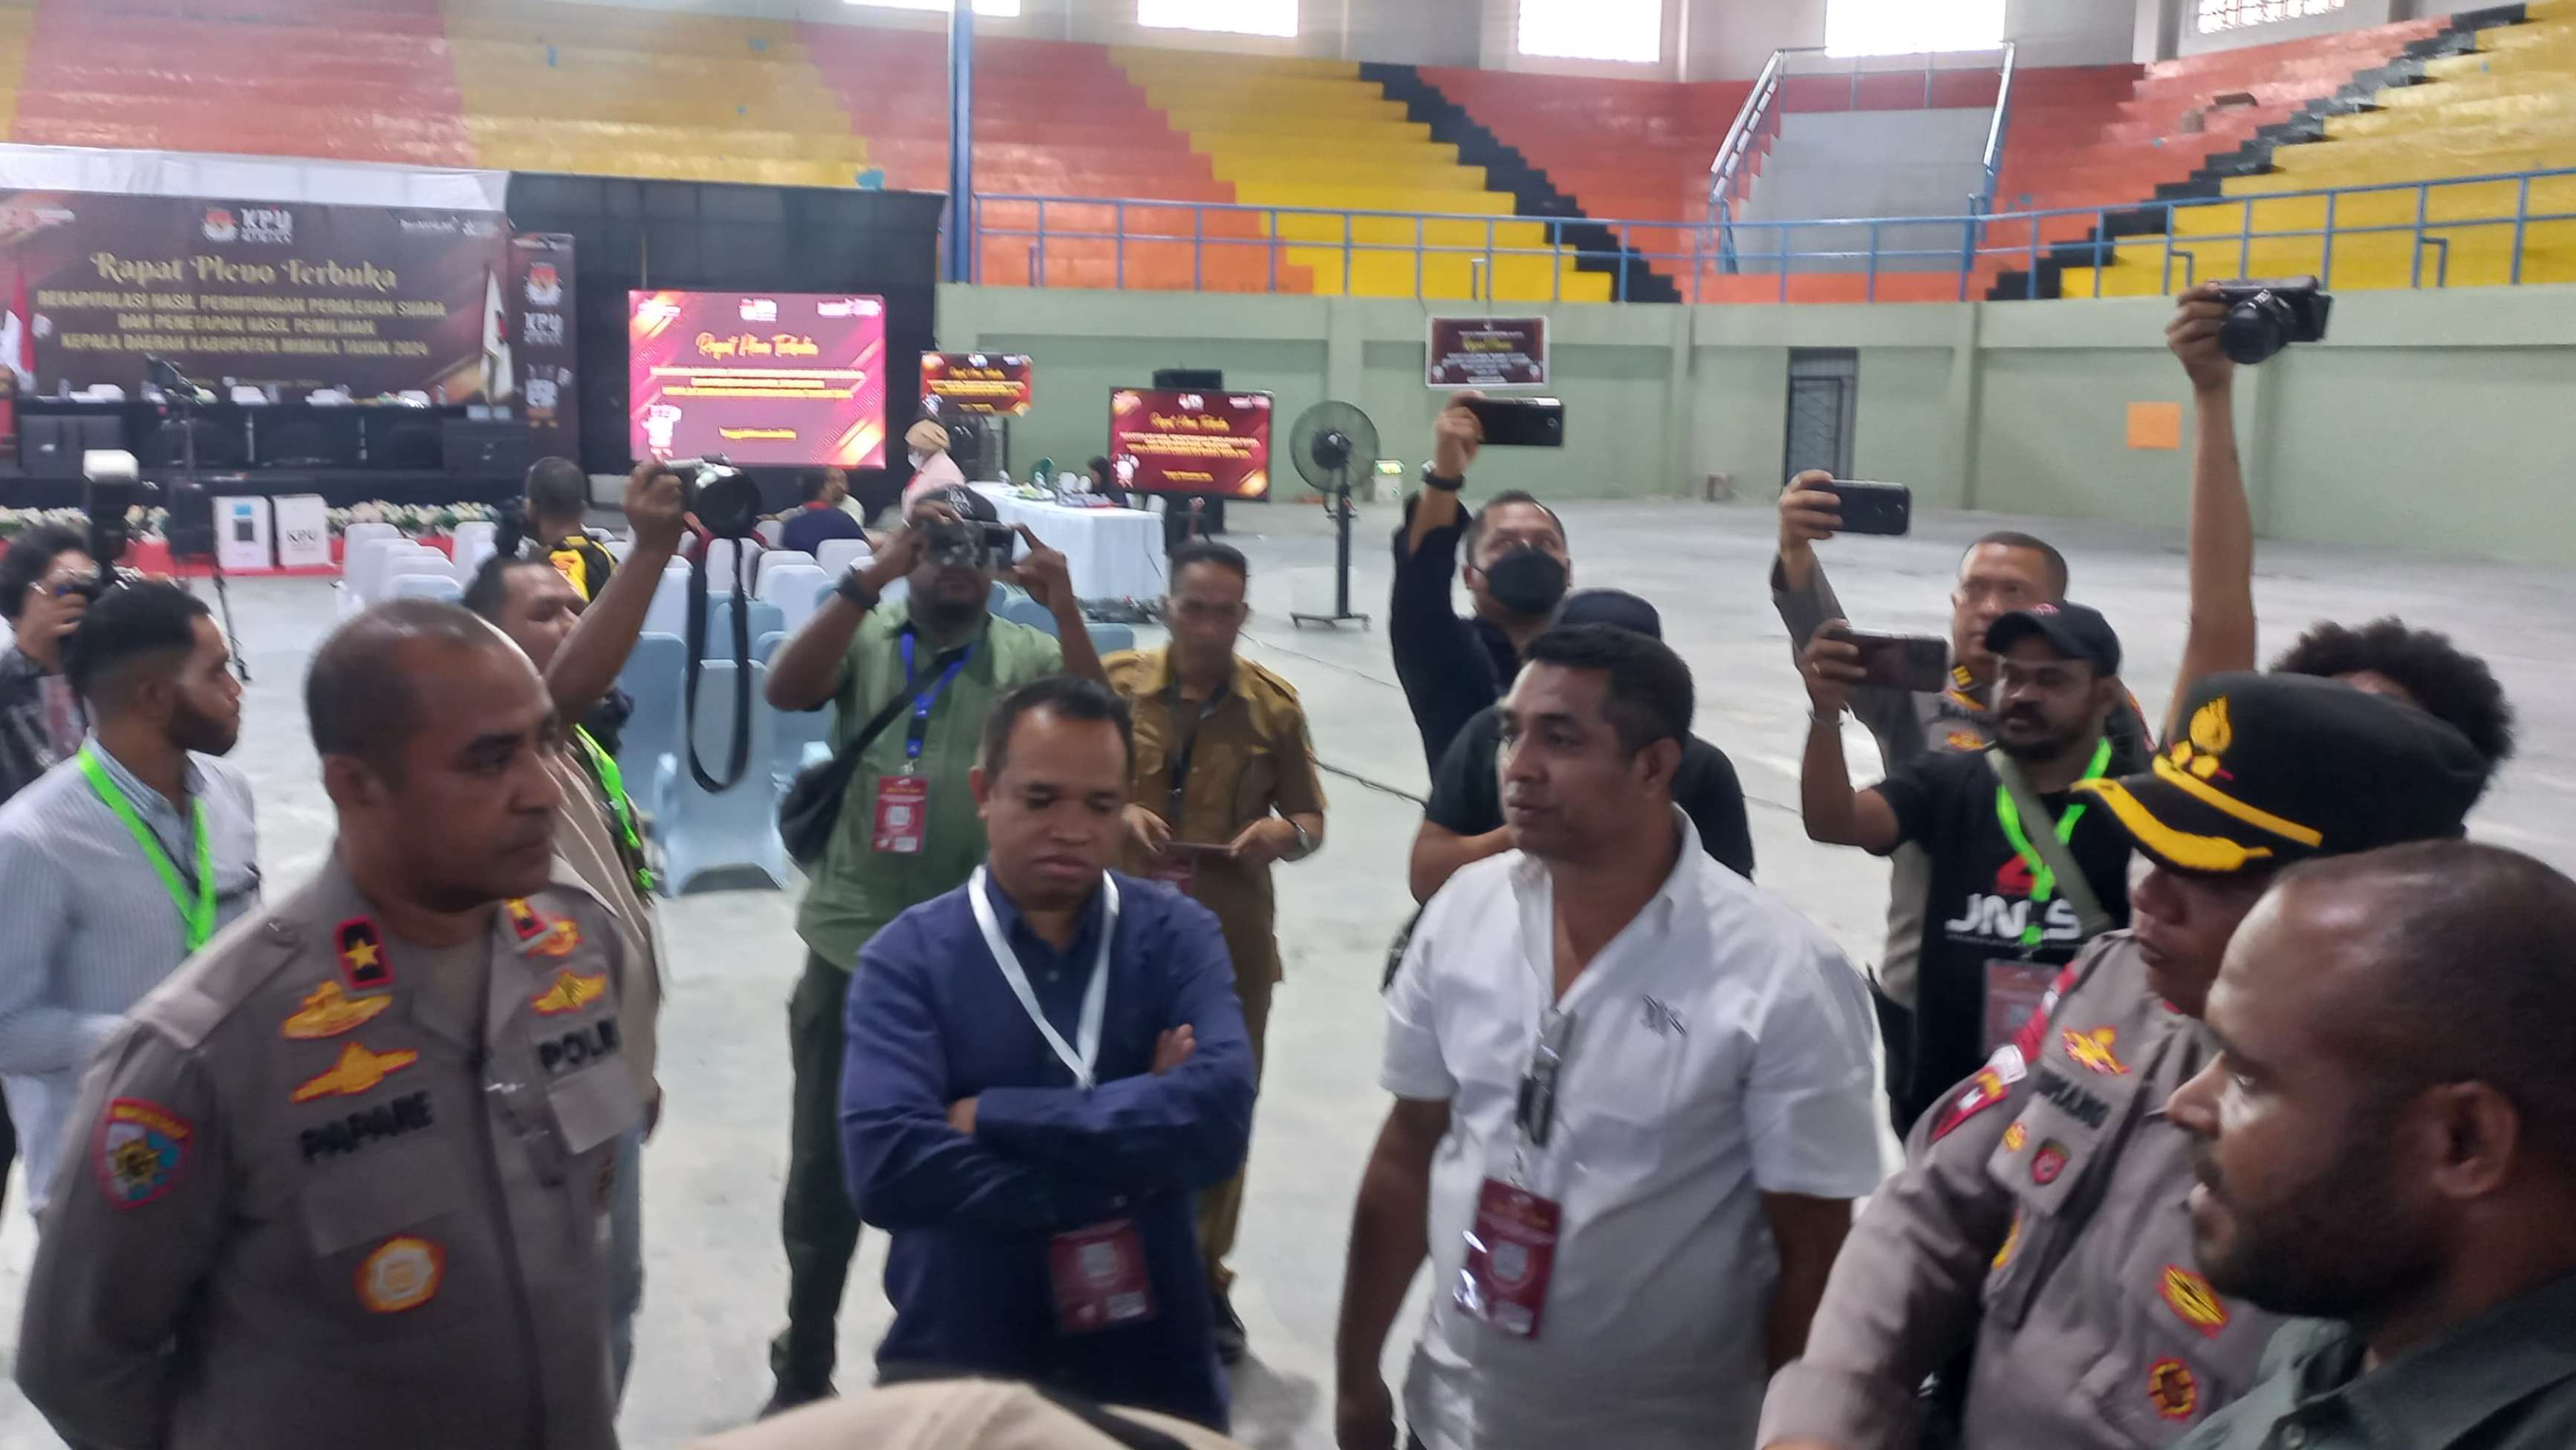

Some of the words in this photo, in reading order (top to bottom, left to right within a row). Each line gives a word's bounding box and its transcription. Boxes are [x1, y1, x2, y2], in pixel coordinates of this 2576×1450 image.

[89, 251, 183, 287] Rapat
[189, 254, 276, 285] Pleno
[280, 259, 397, 294] Terbuka
